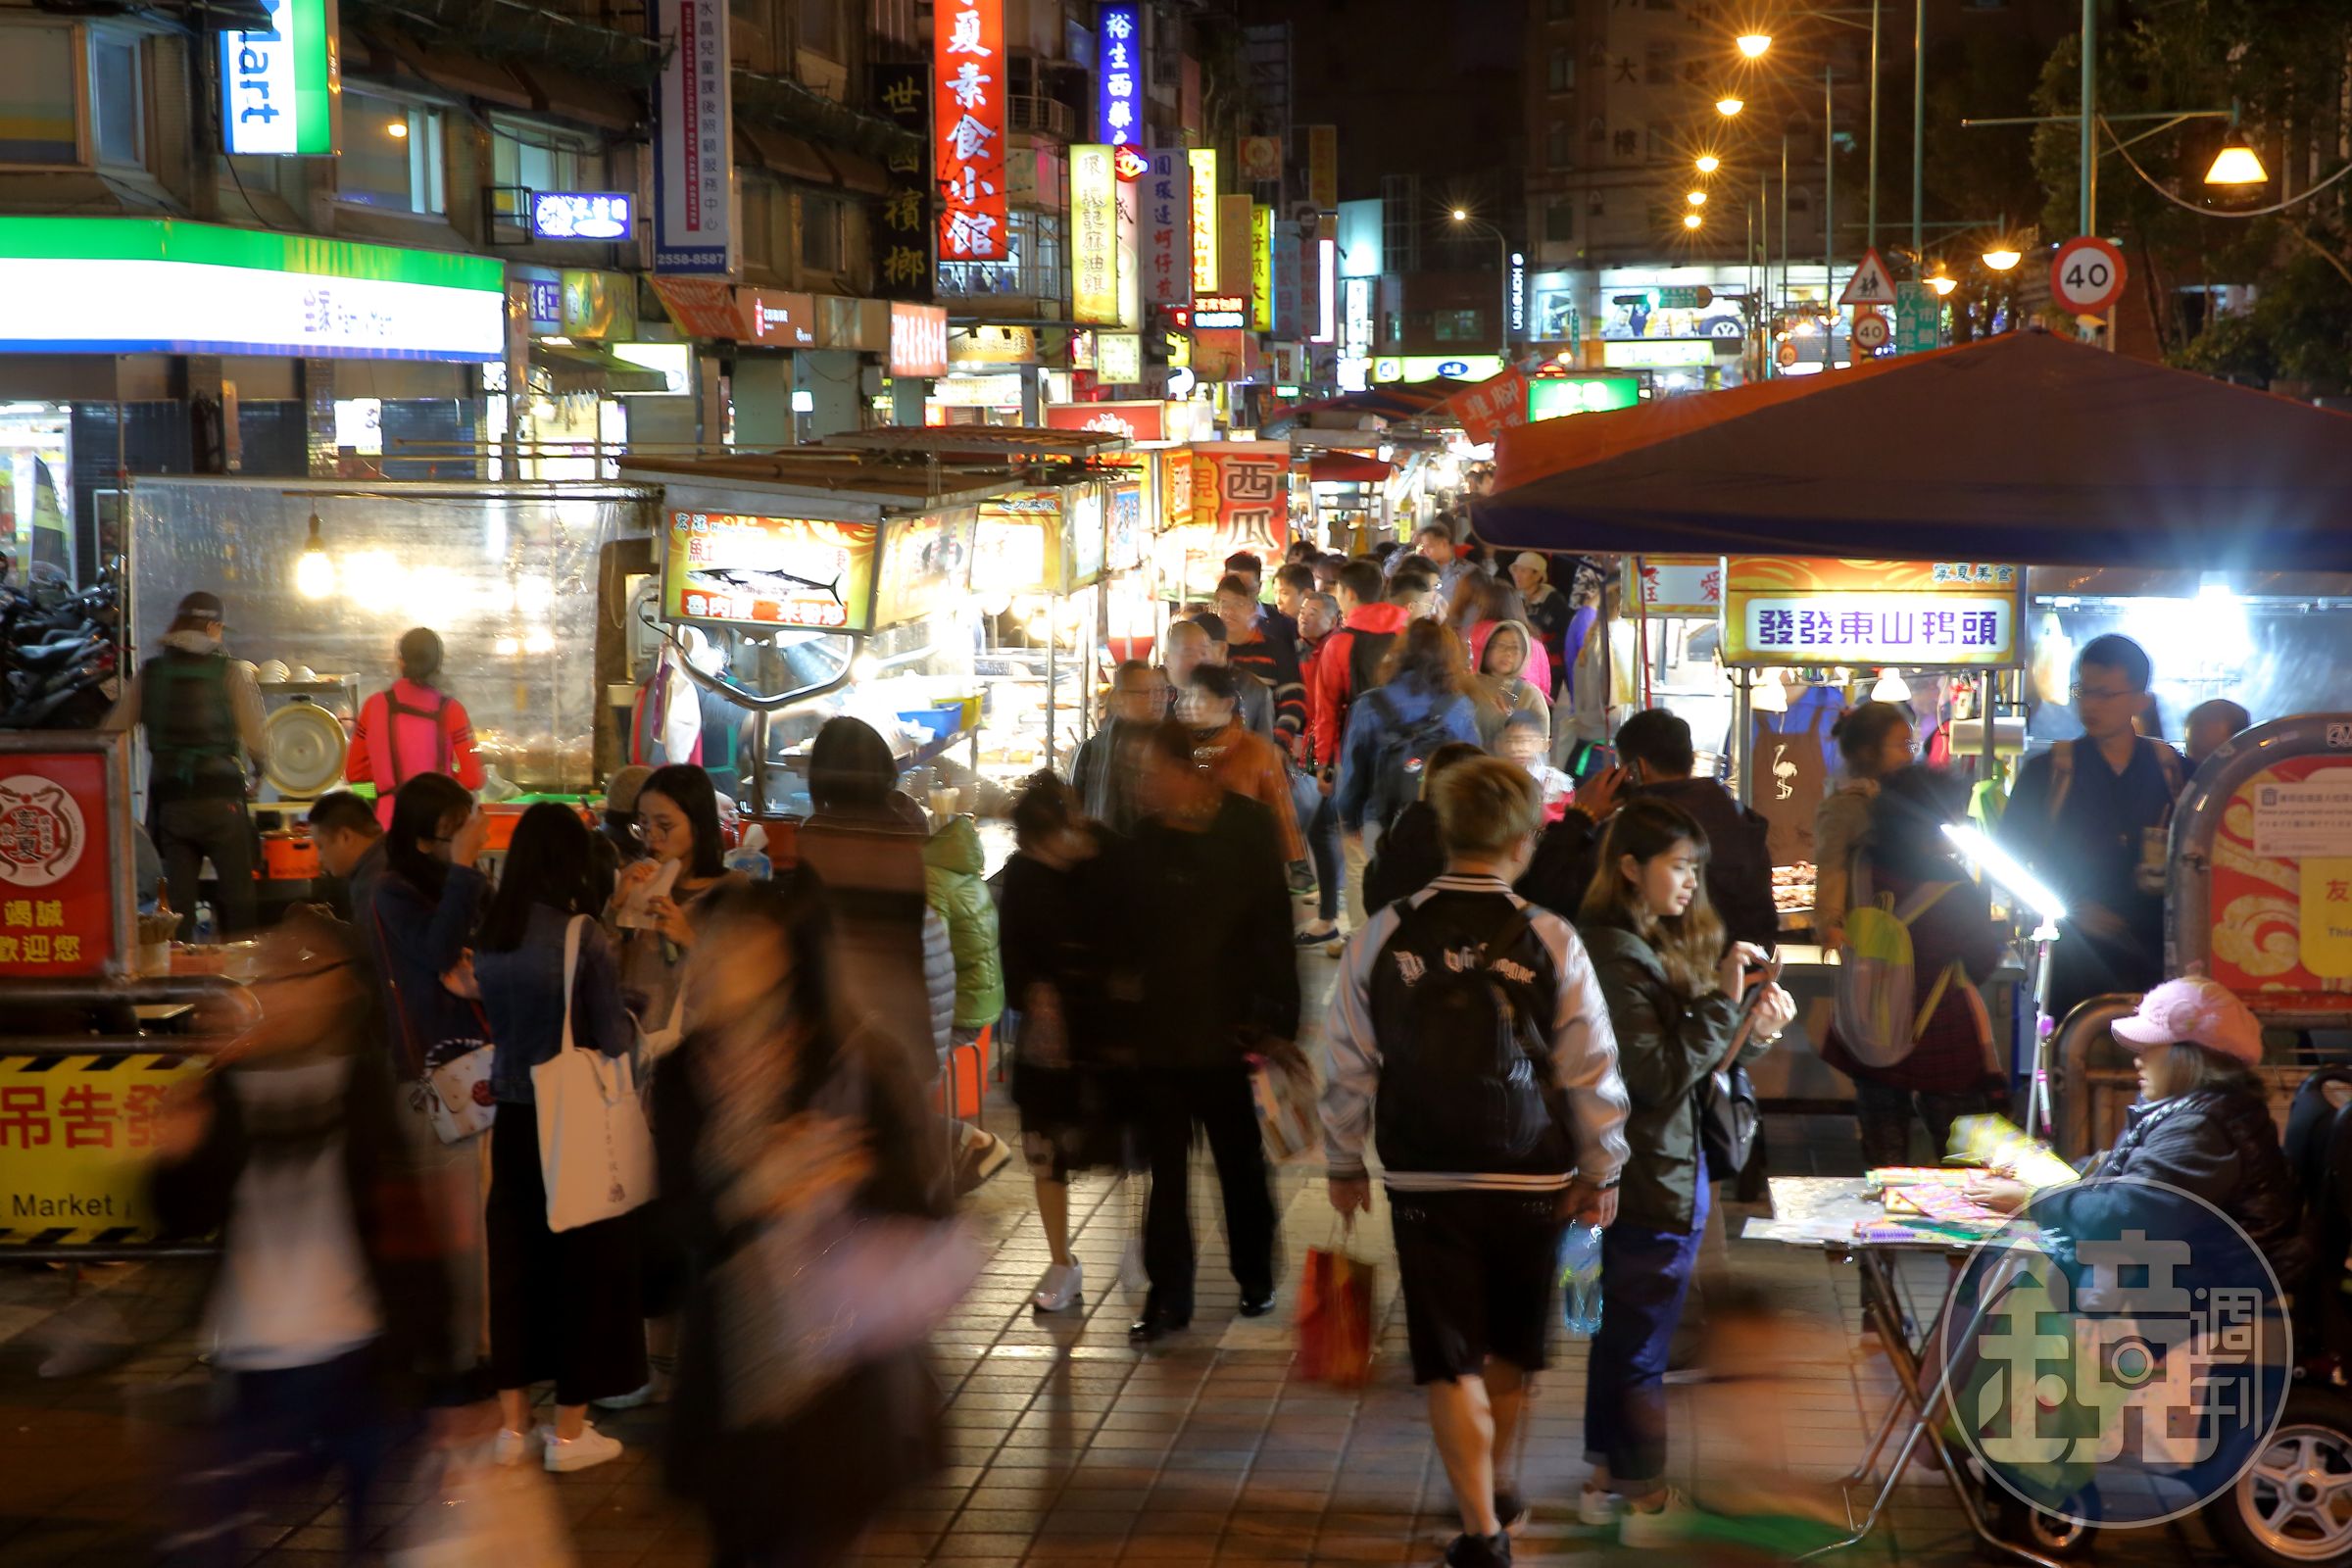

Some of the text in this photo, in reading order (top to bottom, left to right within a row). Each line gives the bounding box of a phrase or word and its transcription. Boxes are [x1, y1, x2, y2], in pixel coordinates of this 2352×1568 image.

[945, 0, 998, 257] 夏素食小館
[657, 252, 725, 266] 2558-8587
[2065, 264, 2109, 288] 40
[1860, 325, 1883, 339] 40
[1226, 461, 1278, 549] 西瓜
[1758, 610, 1998, 645] 發發東山鴨頭
[12, 1193, 115, 1216] Market
